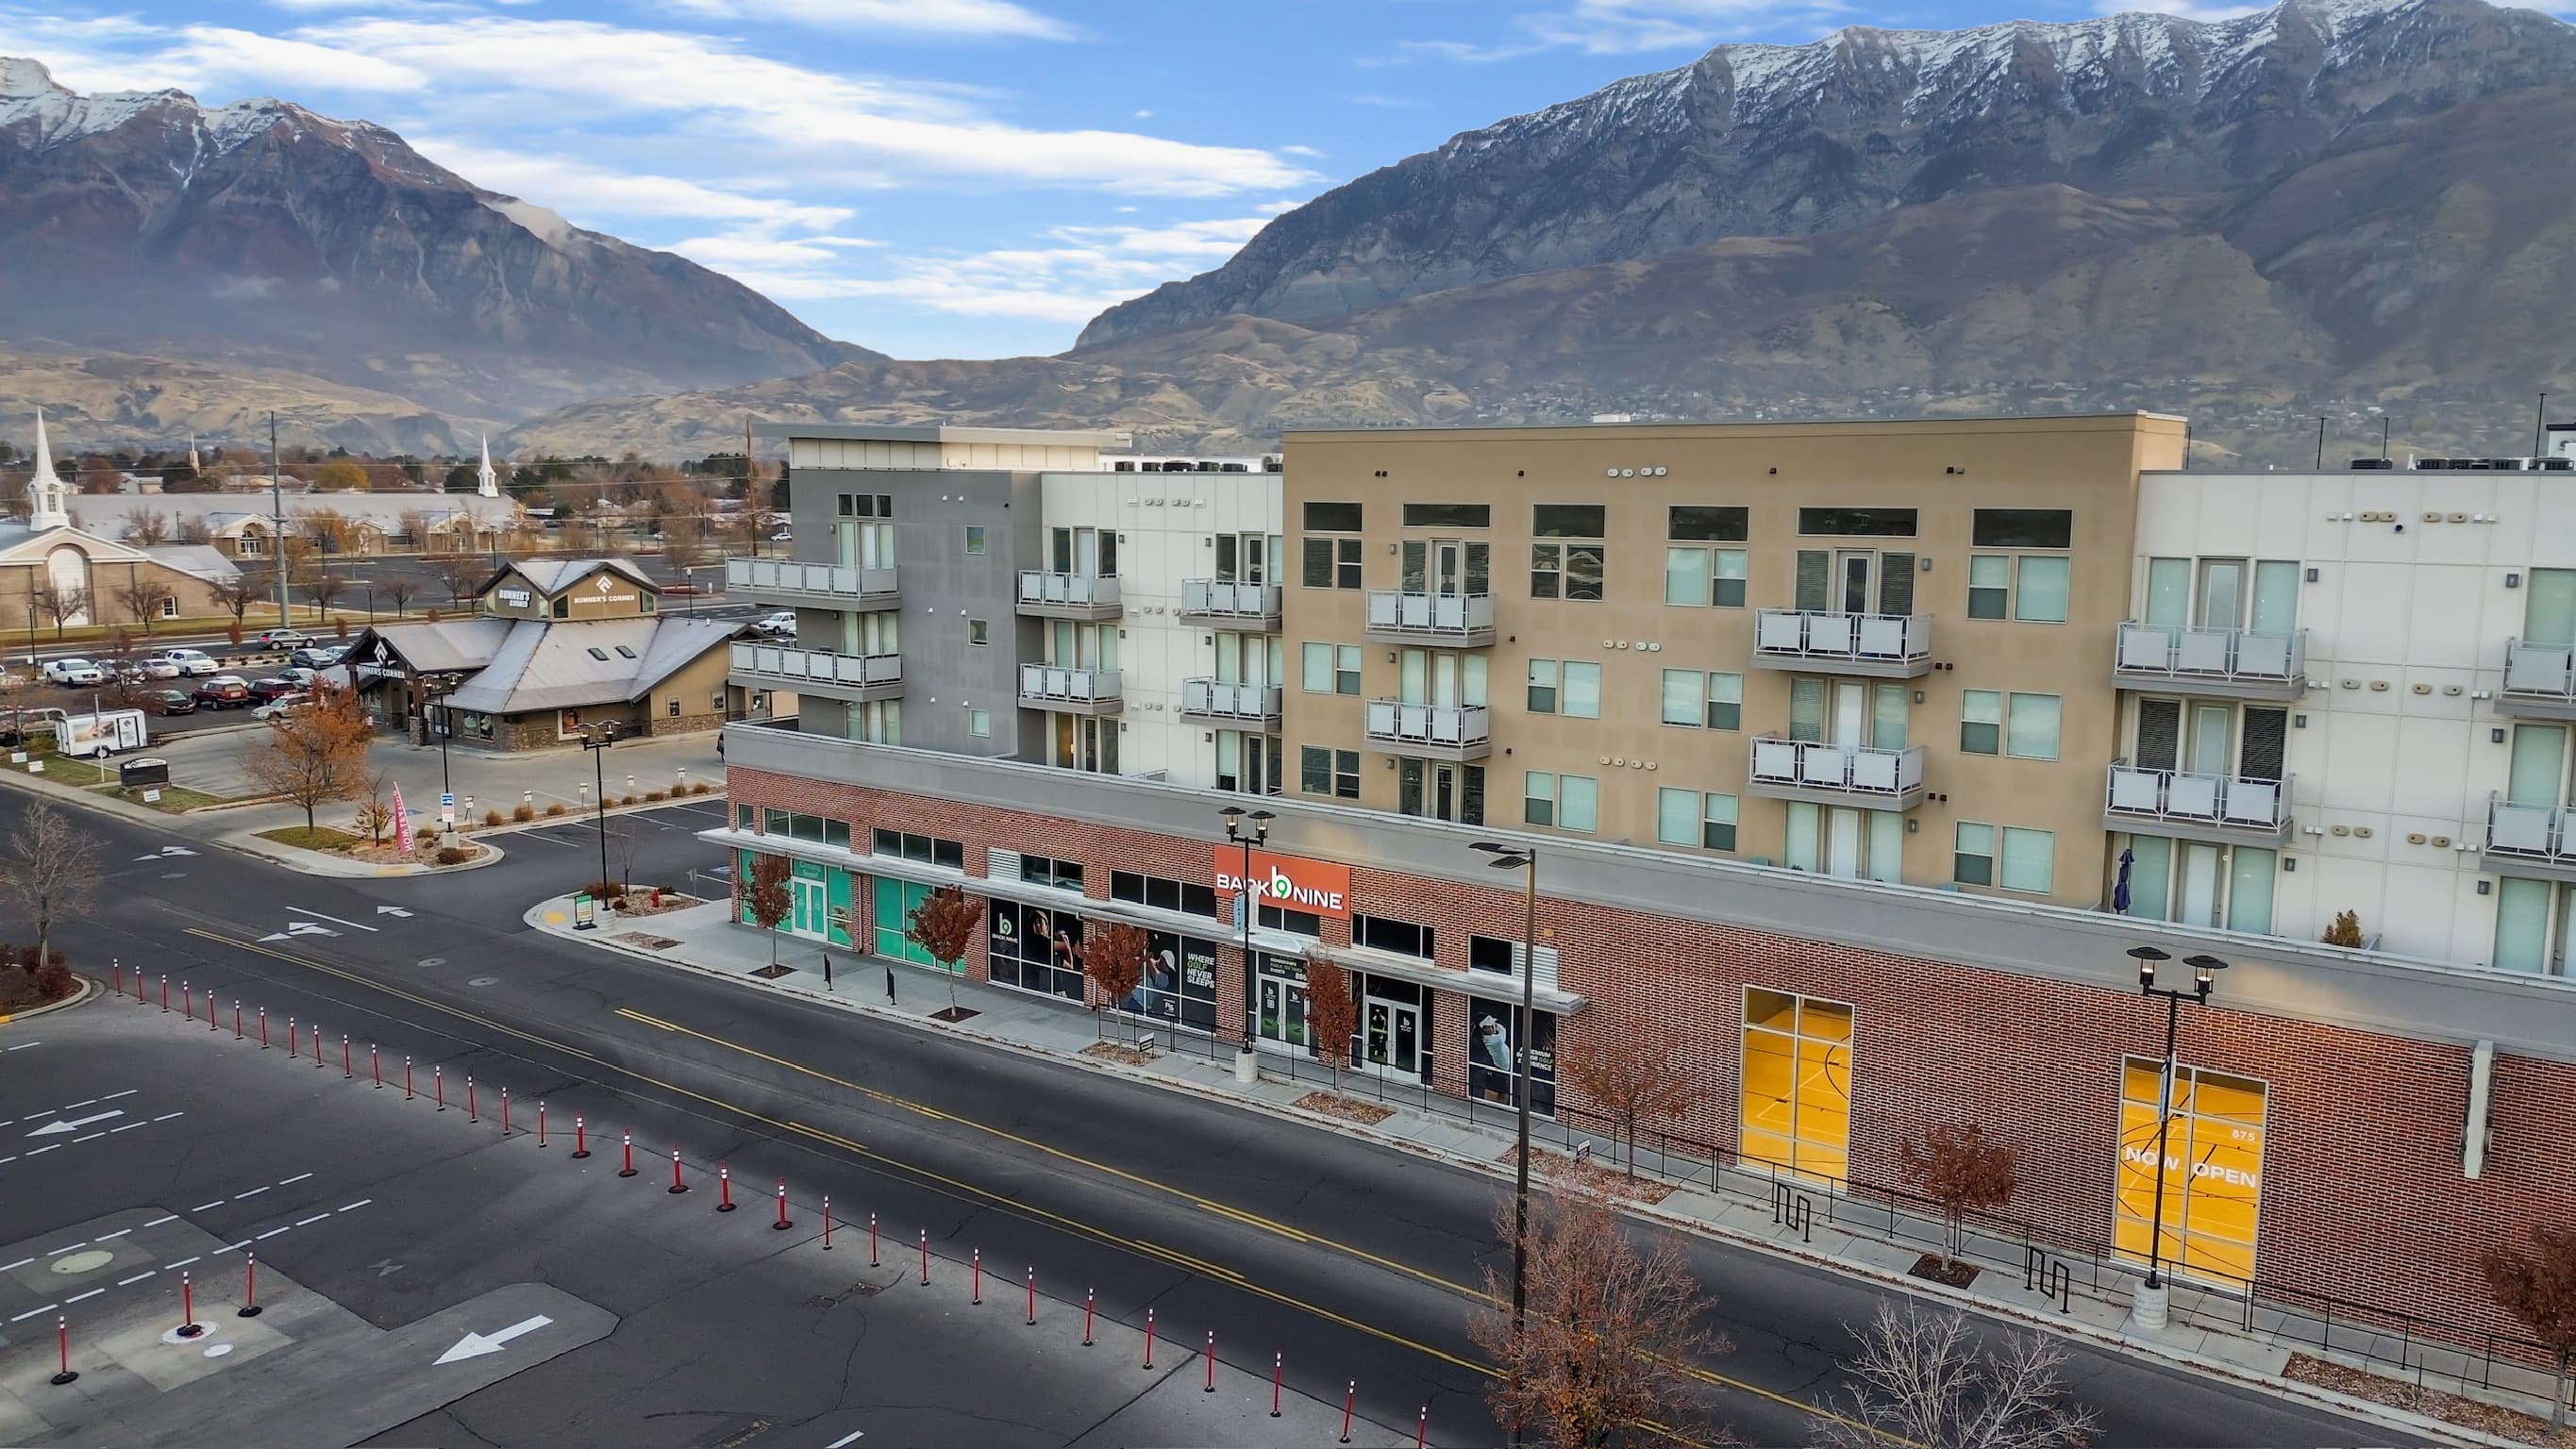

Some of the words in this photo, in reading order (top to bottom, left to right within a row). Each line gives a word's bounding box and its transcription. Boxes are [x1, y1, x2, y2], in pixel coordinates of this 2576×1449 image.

[574, 595, 607, 604] RUNNER'S
[609, 594, 635, 603] CORNER
[382, 669, 405, 679] CORNER
[1294, 885, 1344, 910] NINE
[1187, 952, 1215, 966] WHERE
[1187, 959, 1208, 971] GOLF
[1186, 968, 1213, 980] NEVER
[1186, 975, 1215, 990] SLEEPS
[1538, 1057, 1554, 1065] GOLF
[2232, 1129, 2255, 1141] 875
[2125, 1146, 2180, 1171] NOW
[2192, 1161, 2256, 1189] OPEN
